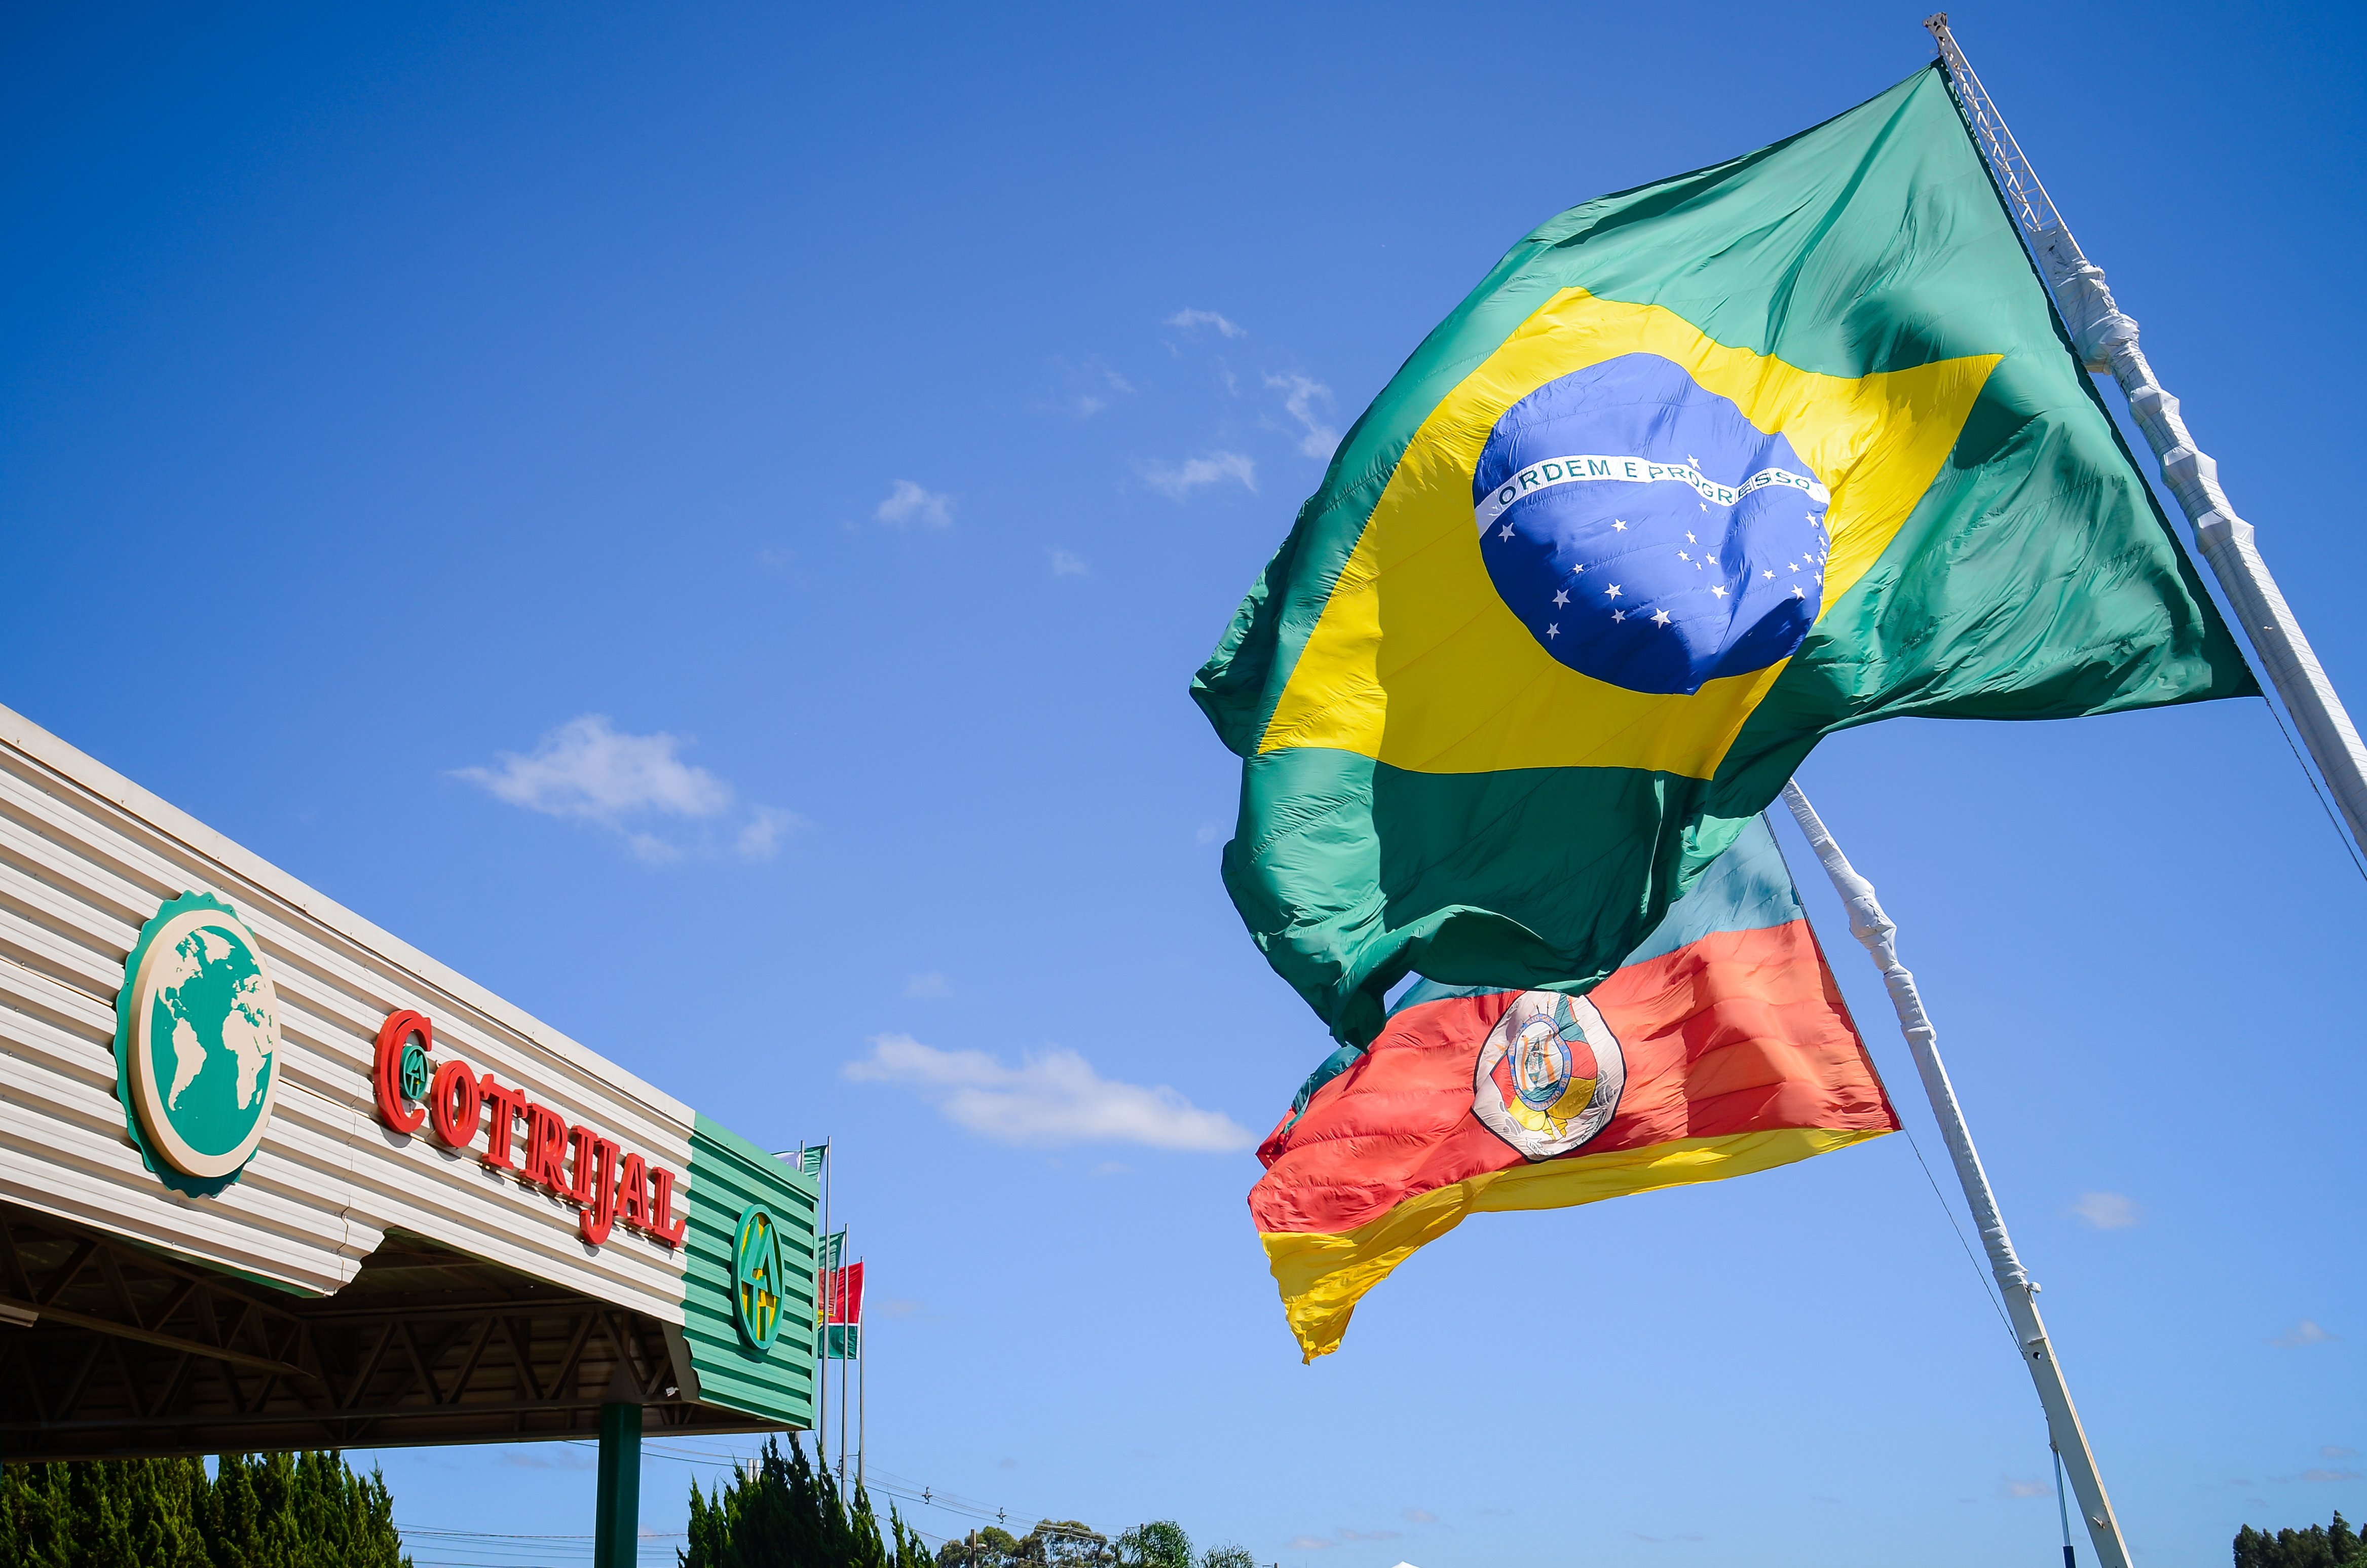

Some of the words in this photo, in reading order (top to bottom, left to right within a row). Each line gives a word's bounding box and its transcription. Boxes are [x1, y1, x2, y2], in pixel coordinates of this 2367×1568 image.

[1498, 459, 1611, 505] ORDEM
[1624, 462, 1638, 478] E
[1648, 465, 1810, 503] PROGRESSO
